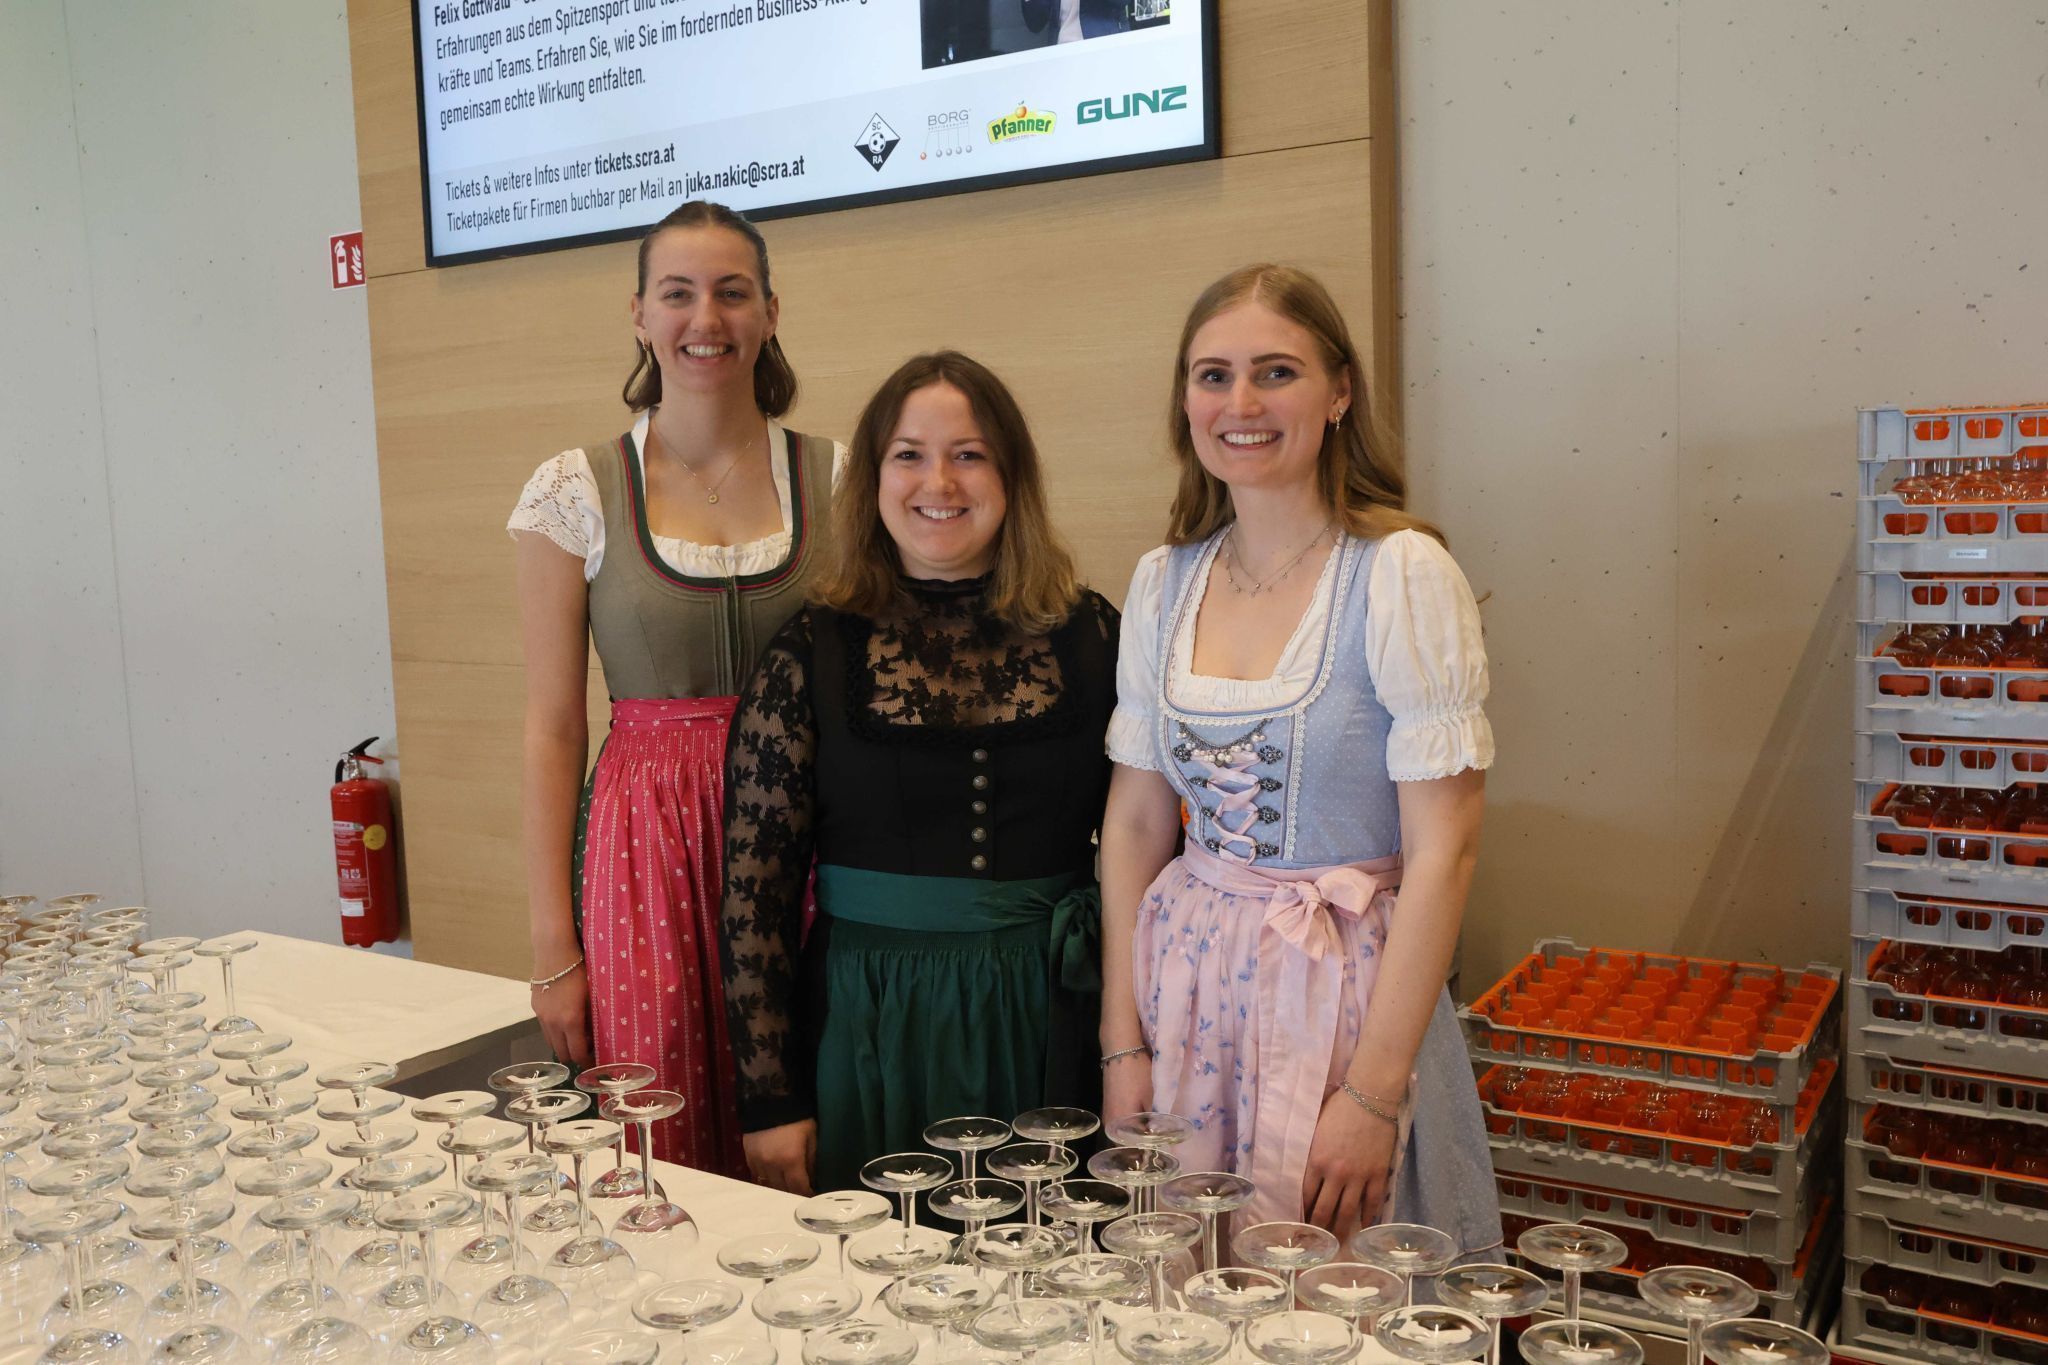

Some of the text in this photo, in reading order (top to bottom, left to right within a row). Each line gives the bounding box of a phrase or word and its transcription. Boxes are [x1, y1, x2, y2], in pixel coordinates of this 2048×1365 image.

[434, 2, 460, 27] Felix
[436, 29, 502, 60] Erfahrungen
[505, 23, 526, 44] aus
[528, 16, 552, 38] dem
[555, 0, 630, 35] Spitzensport
[438, 68, 470, 93] kräfte
[473, 61, 493, 85] und
[495, 58, 534, 80] Teams.
[536, 44, 586, 71] Erfahren
[589, 35, 611, 59] Sie,
[614, 29, 635, 53] wie
[638, 24, 658, 48] Sie
[661, 20, 677, 43] im
[681, 3, 753, 39] fordernden
[440, 66, 646, 131] gemeinsam echte Wirkung entfalten.
[927, 109, 969, 126] BORG
[1076, 85, 1187, 125] GUNZ
[871, 121, 882, 131] SC
[445, 143, 675, 202] Tickets & weitere Infos unter tickets.scra.at
[872, 154, 884, 165] RA
[447, 155, 805, 232] Ticketpakete für Firmen buchbar per Mail an juka.nakic@scra.at
